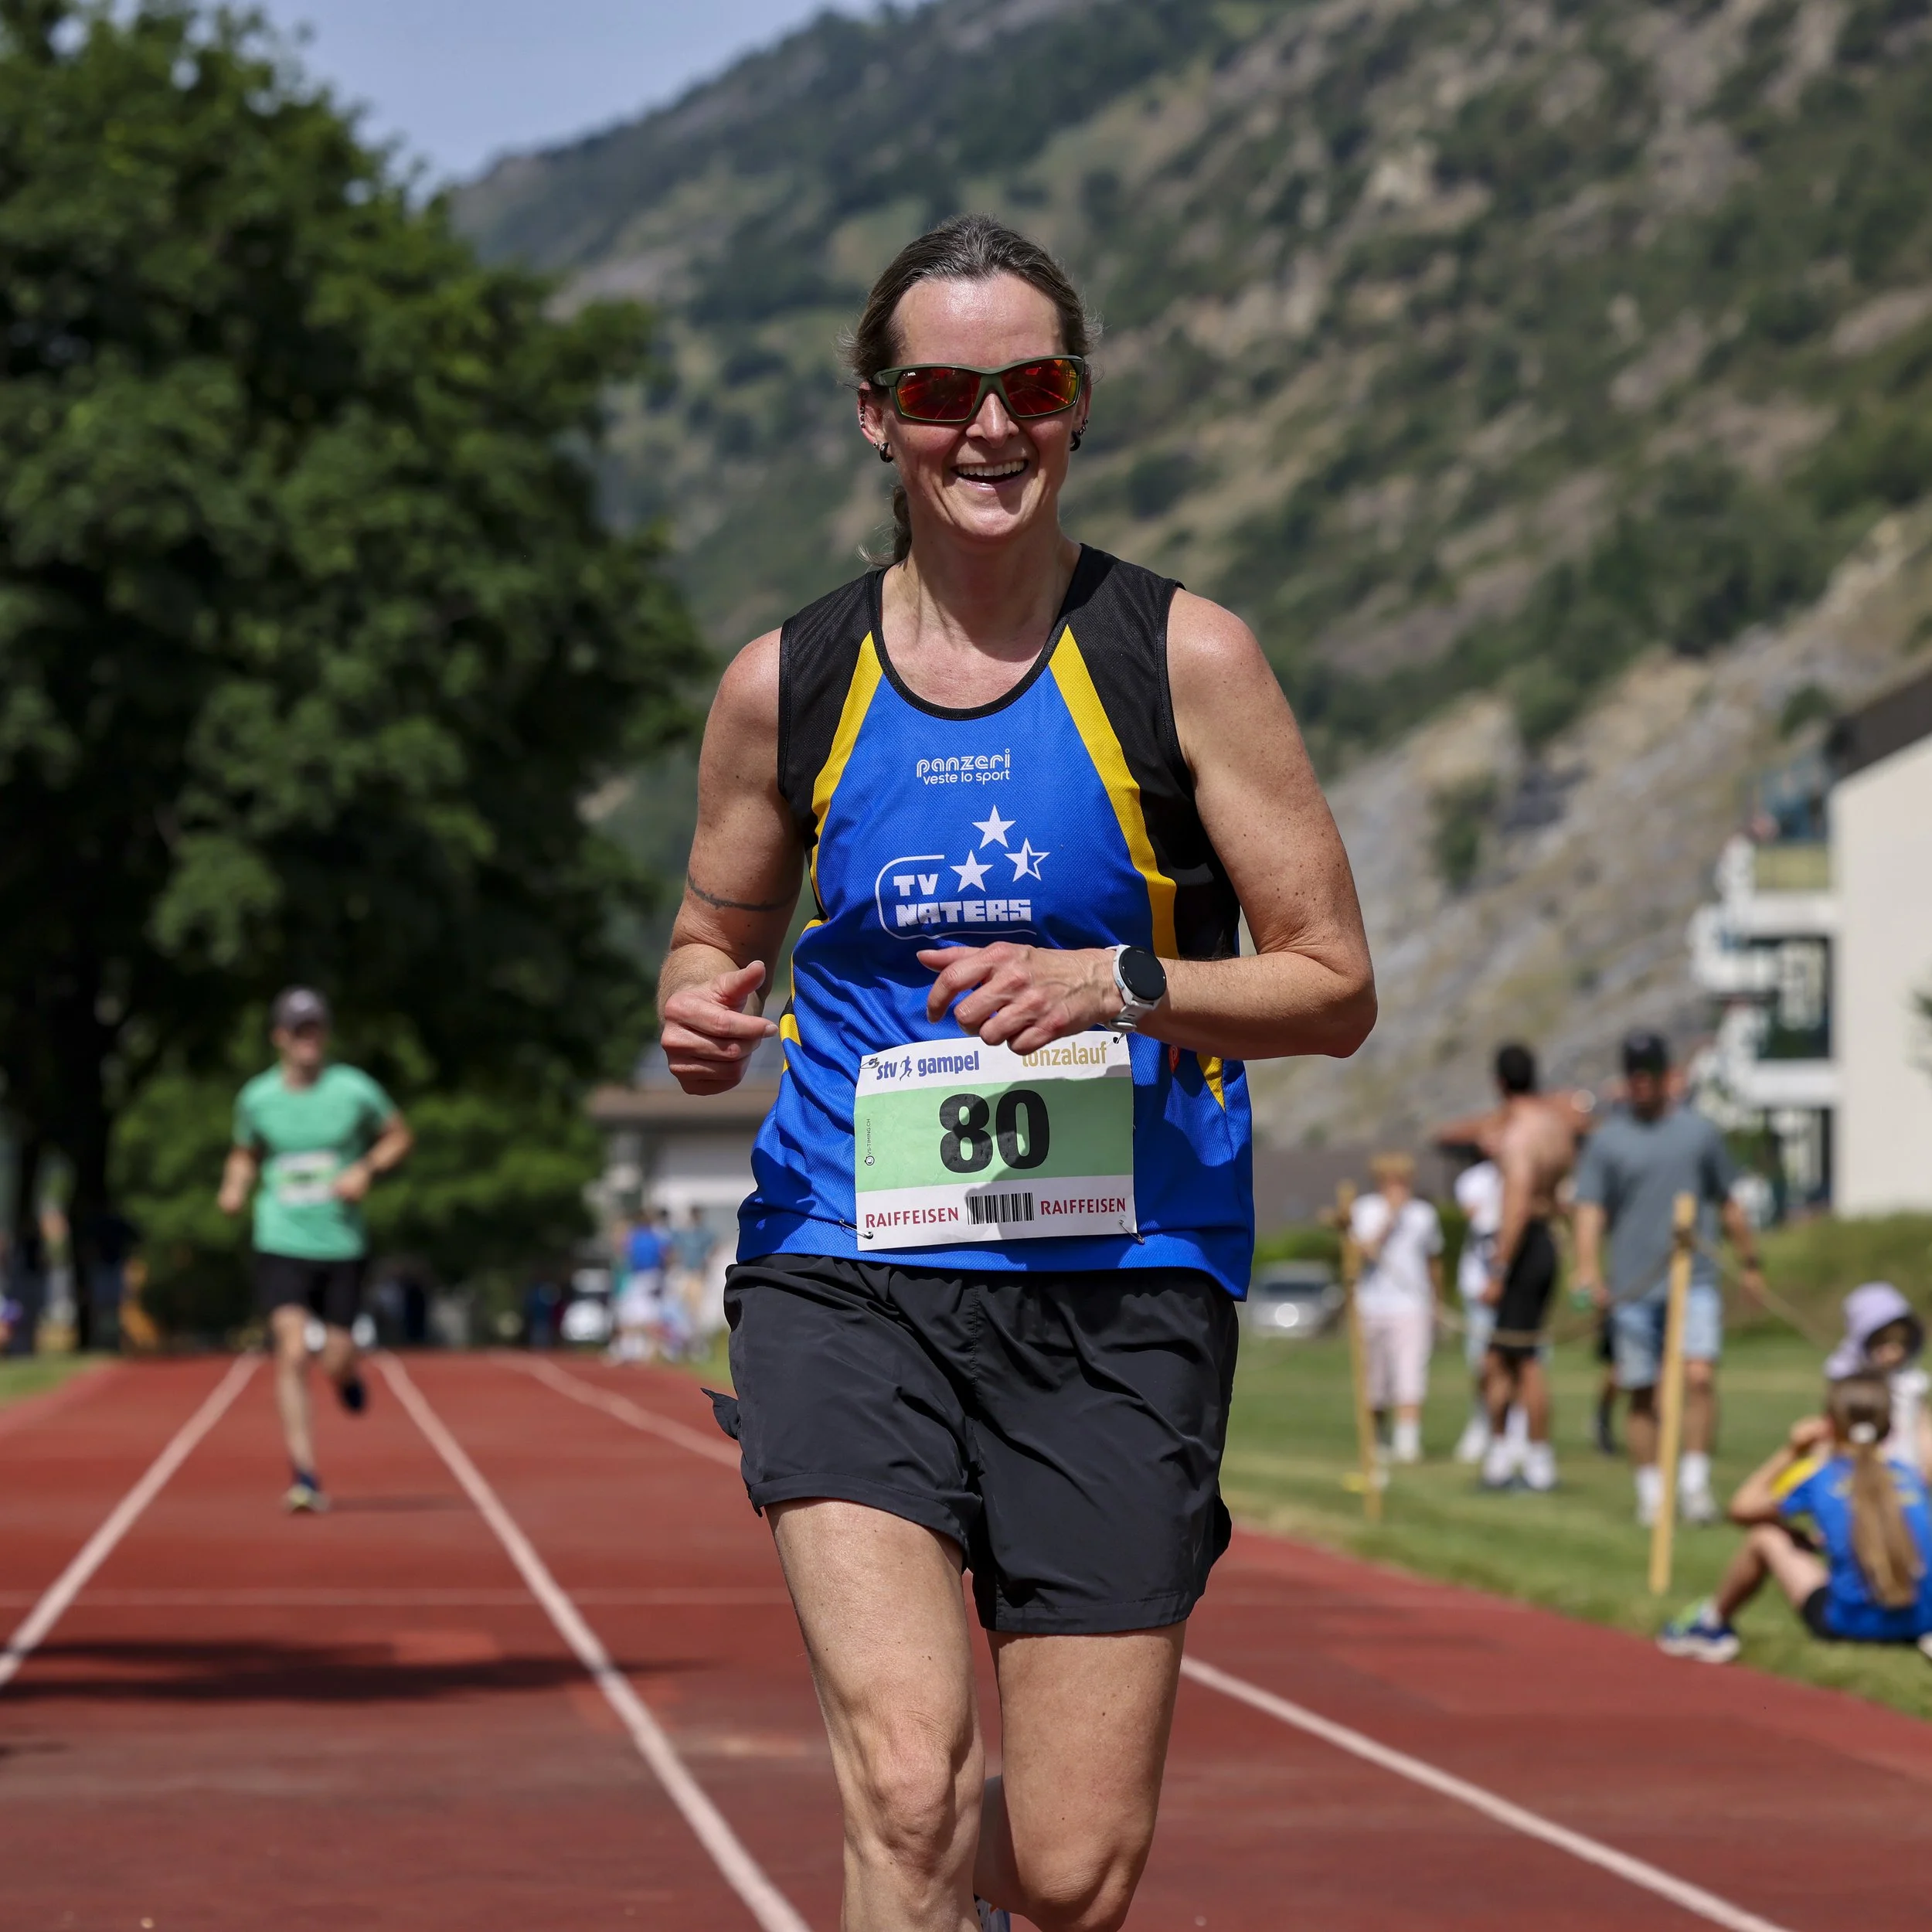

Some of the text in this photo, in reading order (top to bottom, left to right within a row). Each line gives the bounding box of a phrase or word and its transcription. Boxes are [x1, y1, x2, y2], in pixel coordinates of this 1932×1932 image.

[917, 748, 1010, 777] panzeri
[923, 769, 1010, 785] veste lo sport
[893, 874, 938, 896] TV
[896, 899, 1032, 927] NATERS
[876, 1050, 980, 1080] stv gampel
[938, 1089, 1050, 1174] 80
[865, 1207, 959, 1228] RAIFFEISEN
[1040, 1198, 1126, 1216] RAIFFEISEN
